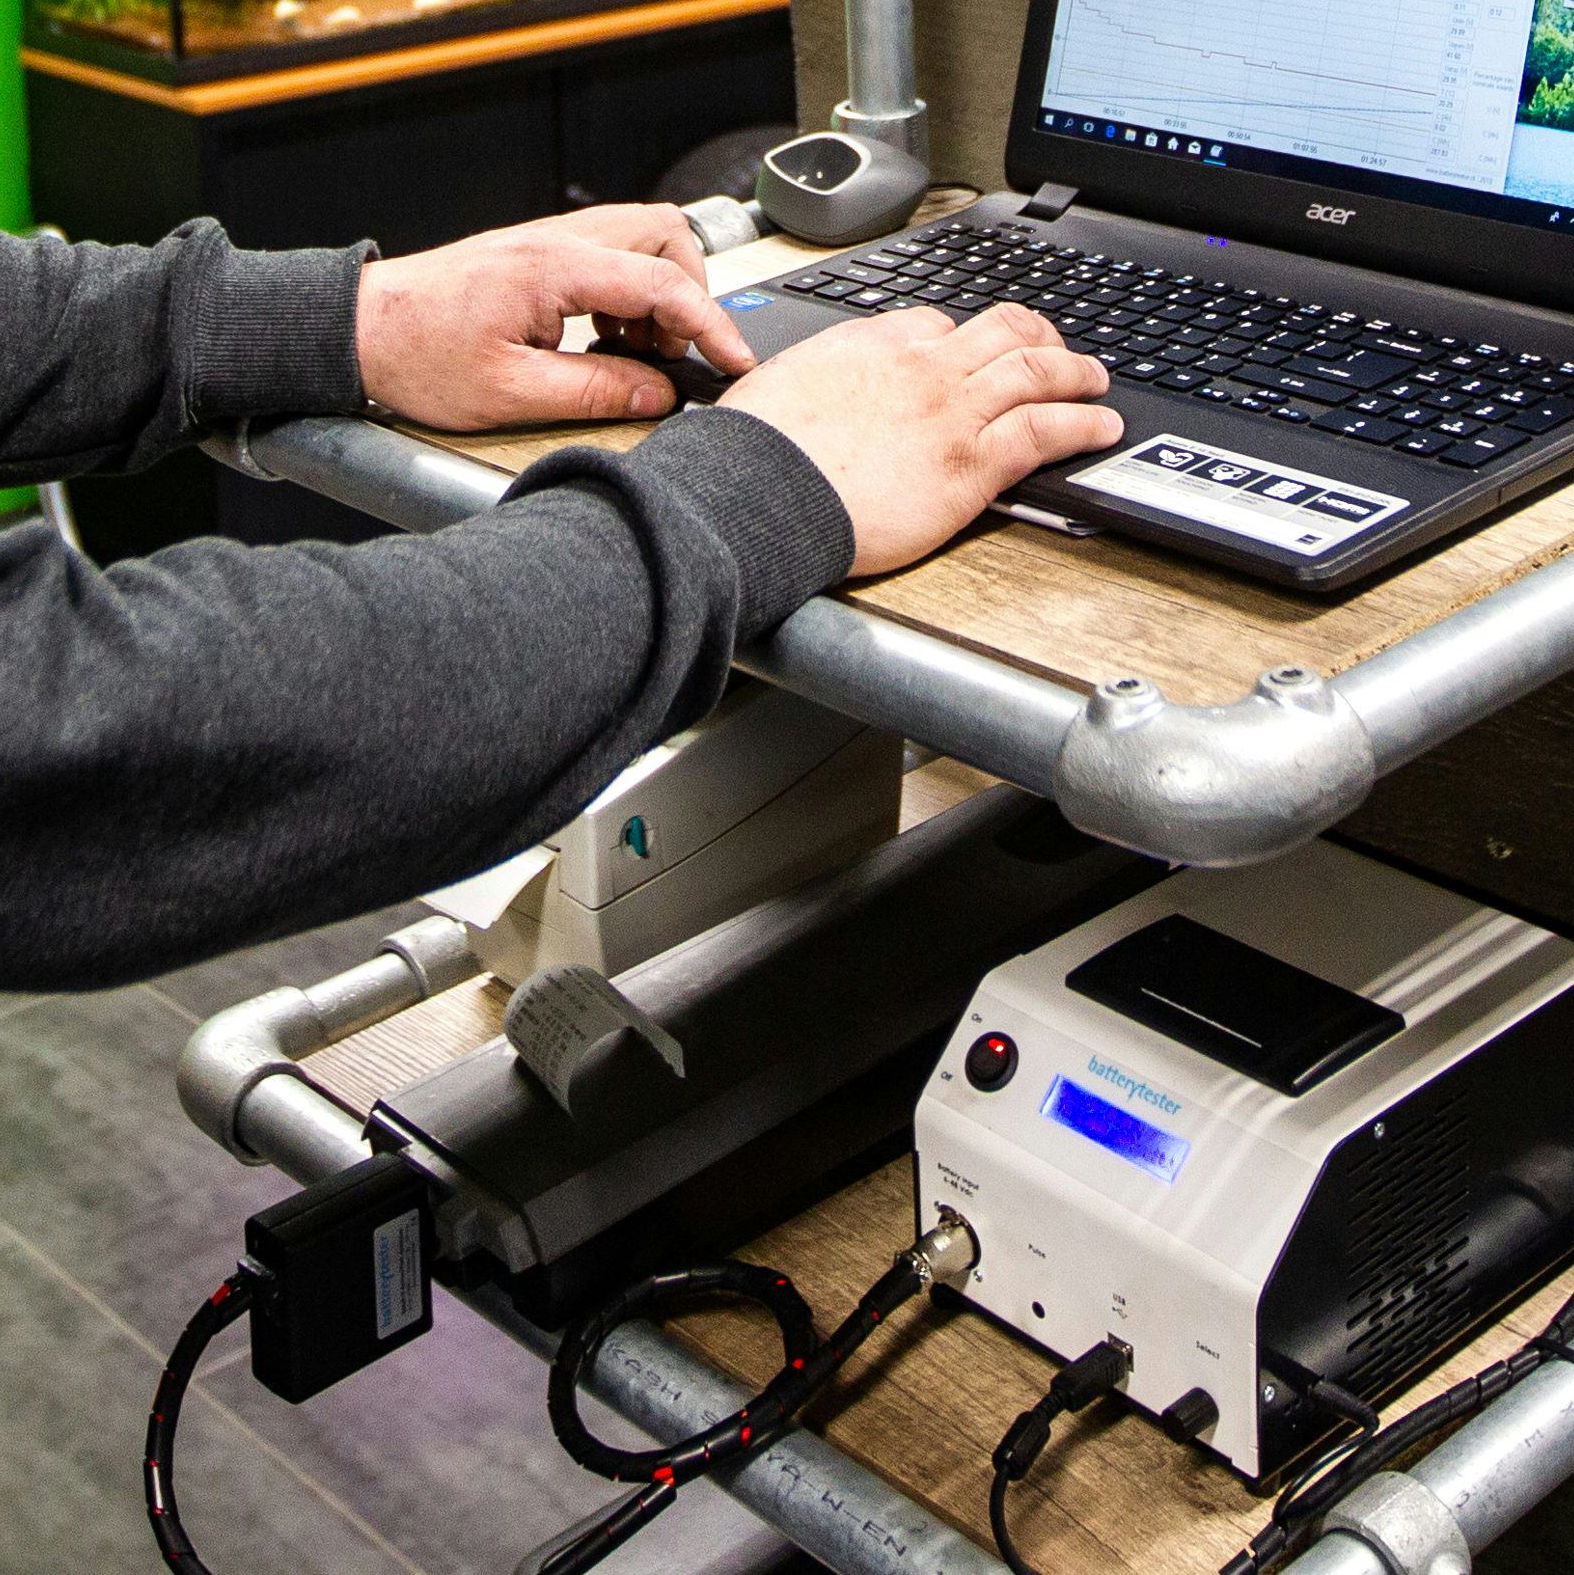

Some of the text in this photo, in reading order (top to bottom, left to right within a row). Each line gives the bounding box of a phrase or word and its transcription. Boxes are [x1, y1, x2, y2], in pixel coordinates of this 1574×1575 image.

[1306, 203, 1356, 225] acer
[971, 1013, 983, 1024] On
[940, 1070, 953, 1081] Off
[1087, 1054, 1182, 1115] batterytester
[1028, 1243, 1046, 1259] Pulse
[1112, 1293, 1126, 1307] USB
[1195, 1340, 1220, 1360] Select
